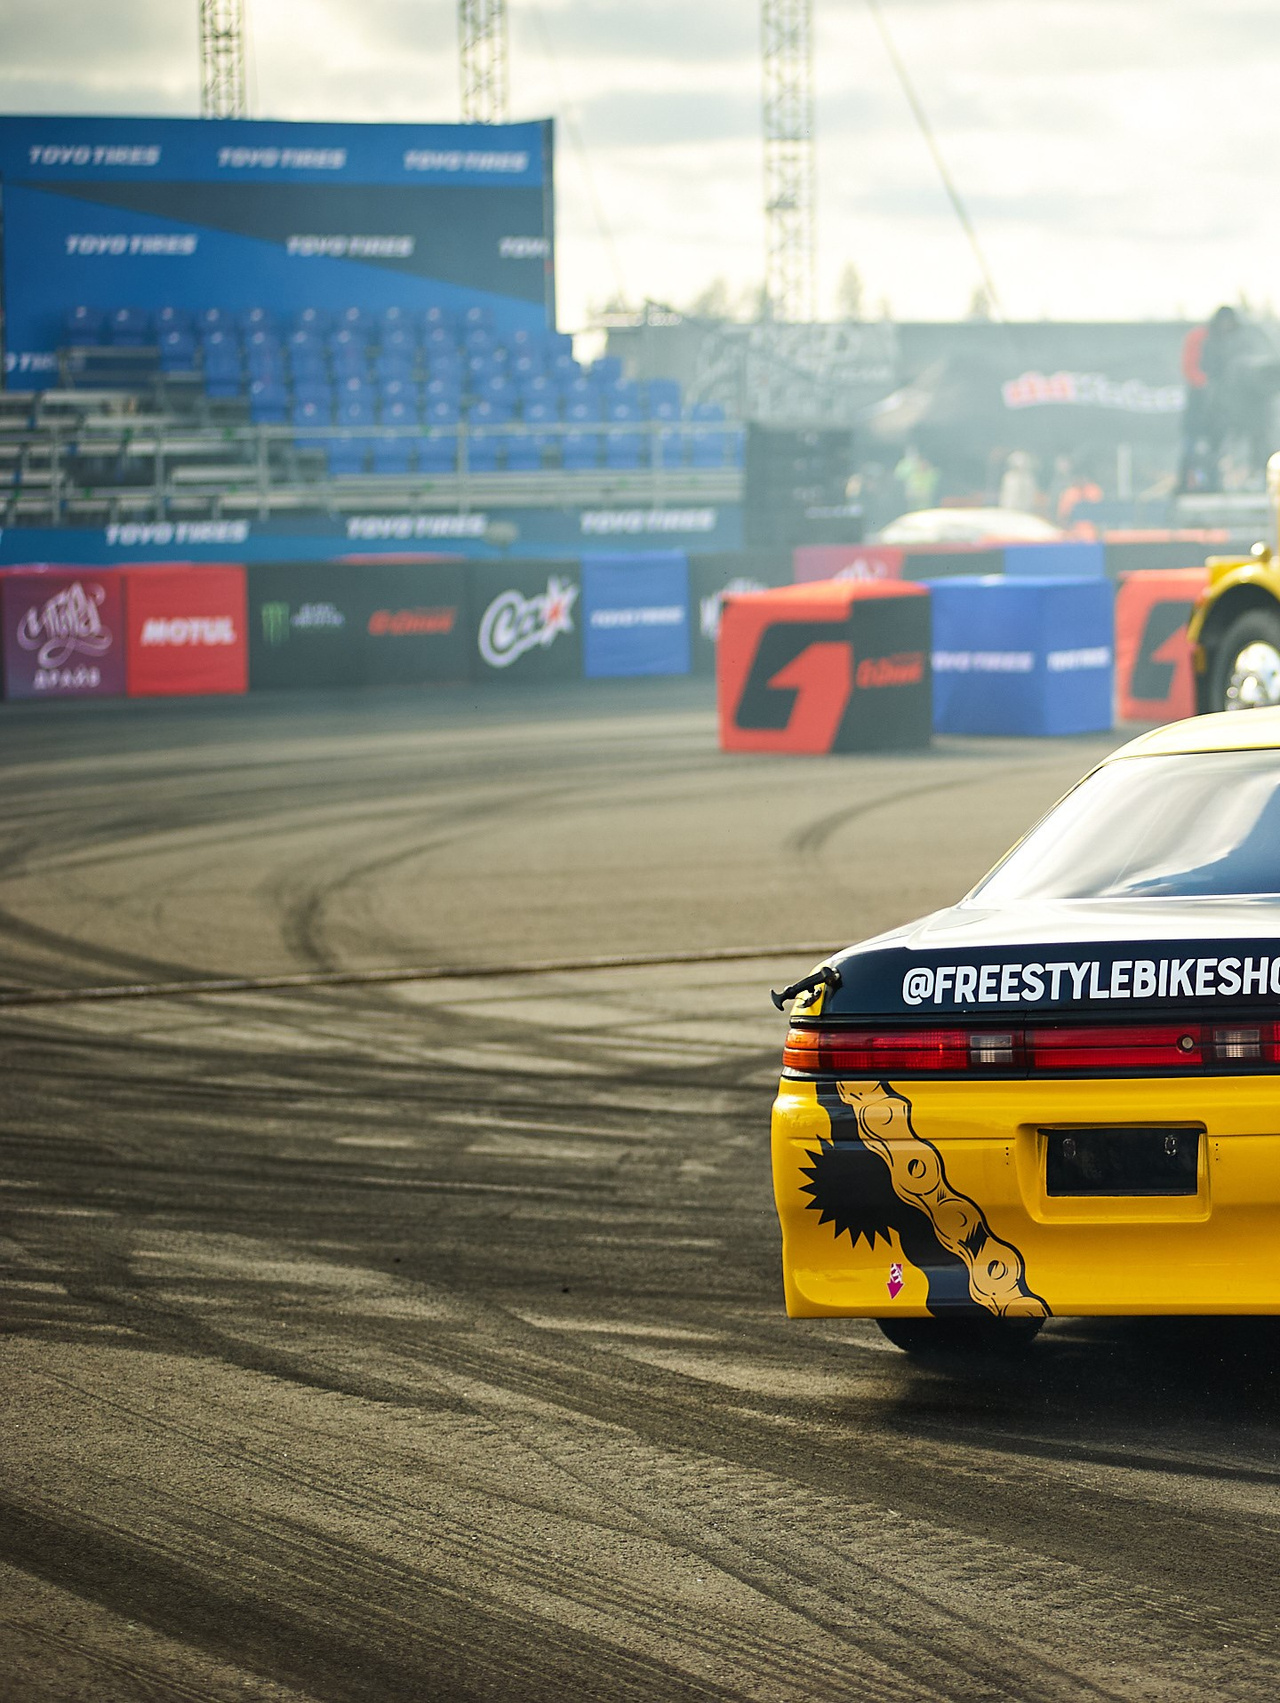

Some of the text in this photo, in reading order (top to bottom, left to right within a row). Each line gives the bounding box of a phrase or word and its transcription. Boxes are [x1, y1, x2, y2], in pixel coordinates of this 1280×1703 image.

[28, 145, 161, 166] TOYO TIRES
[217, 147, 347, 170] TOYO TIRES
[65, 234, 198, 256] TOYO TIRES
[286, 234, 414, 258] TOYO TIRES
[105, 519, 249, 546] TOYO TIRES
[346, 513, 487, 540] TOYO TIRES
[580, 508, 717, 535] TOYO TIRES
[141, 616, 236, 646] MOTUL
